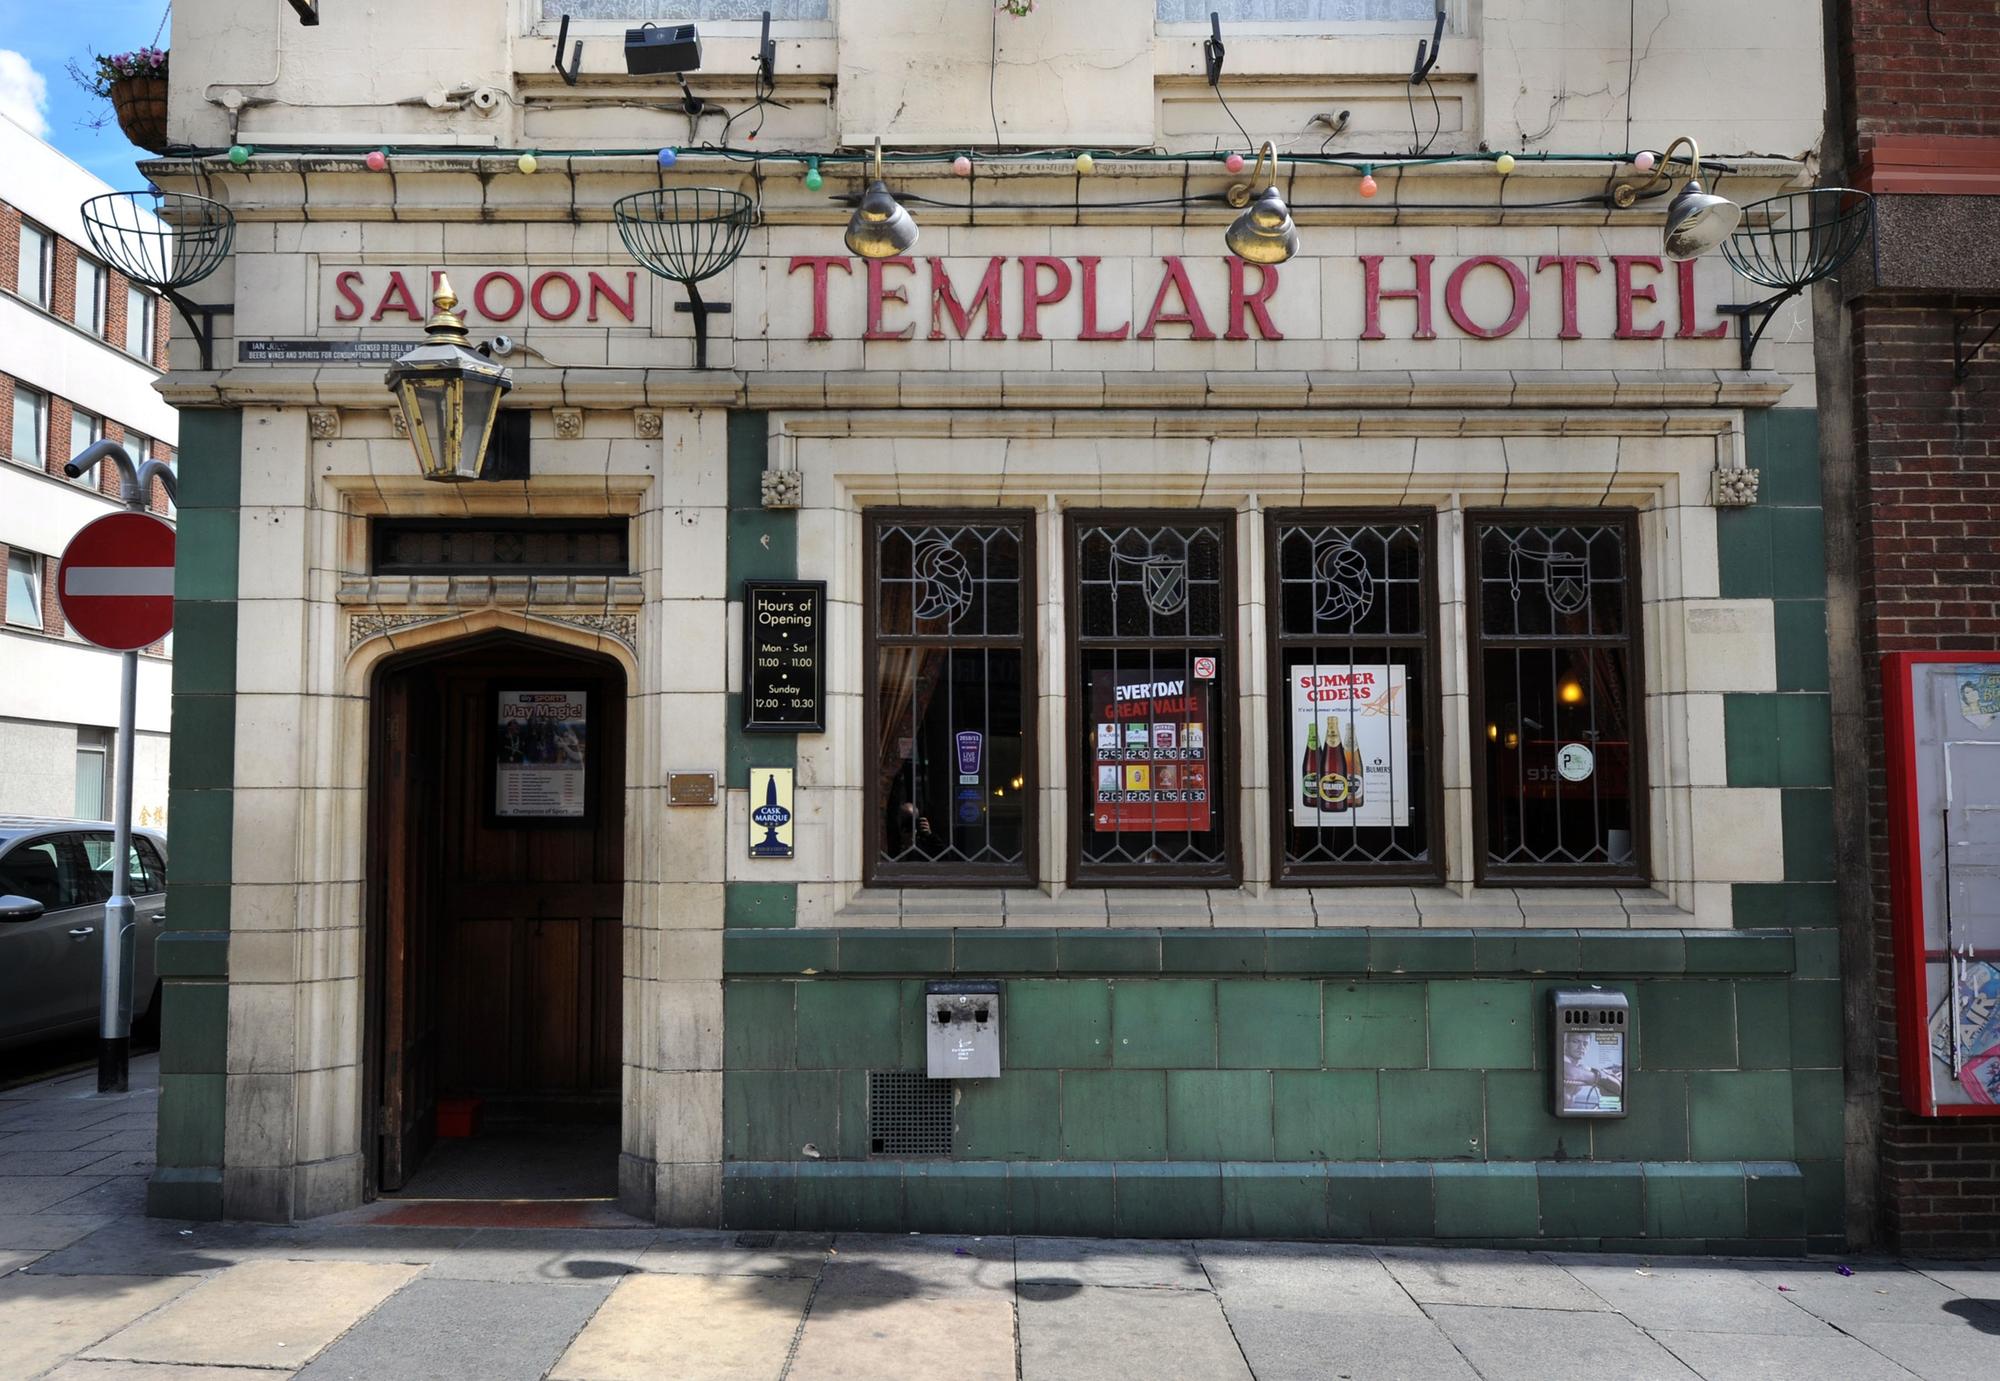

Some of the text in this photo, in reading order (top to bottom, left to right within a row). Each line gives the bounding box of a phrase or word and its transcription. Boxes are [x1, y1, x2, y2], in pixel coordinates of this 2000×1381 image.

[788, 255, 1728, 341] TEMPLAR HOTEL
[758, 599, 812, 612] Hours of
[758, 612, 812, 626] Opening
[762, 644, 782, 652] Mon
[793, 644, 808, 652] Sat
[758, 658, 780, 667] 11.00
[792, 658, 812, 667] 11.00
[1300, 672, 1376, 688] SUMMER
[768, 684, 800, 695] Sunday
[1114, 680, 1184, 701] EVERYDAY
[1306, 687, 1371, 702] CIDERS
[755, 699, 779, 708] 12.00
[791, 699, 814, 708] 10.30
[1105, 696, 1198, 718] GREAT VALUE
[504, 704, 582, 719] May Magic!
